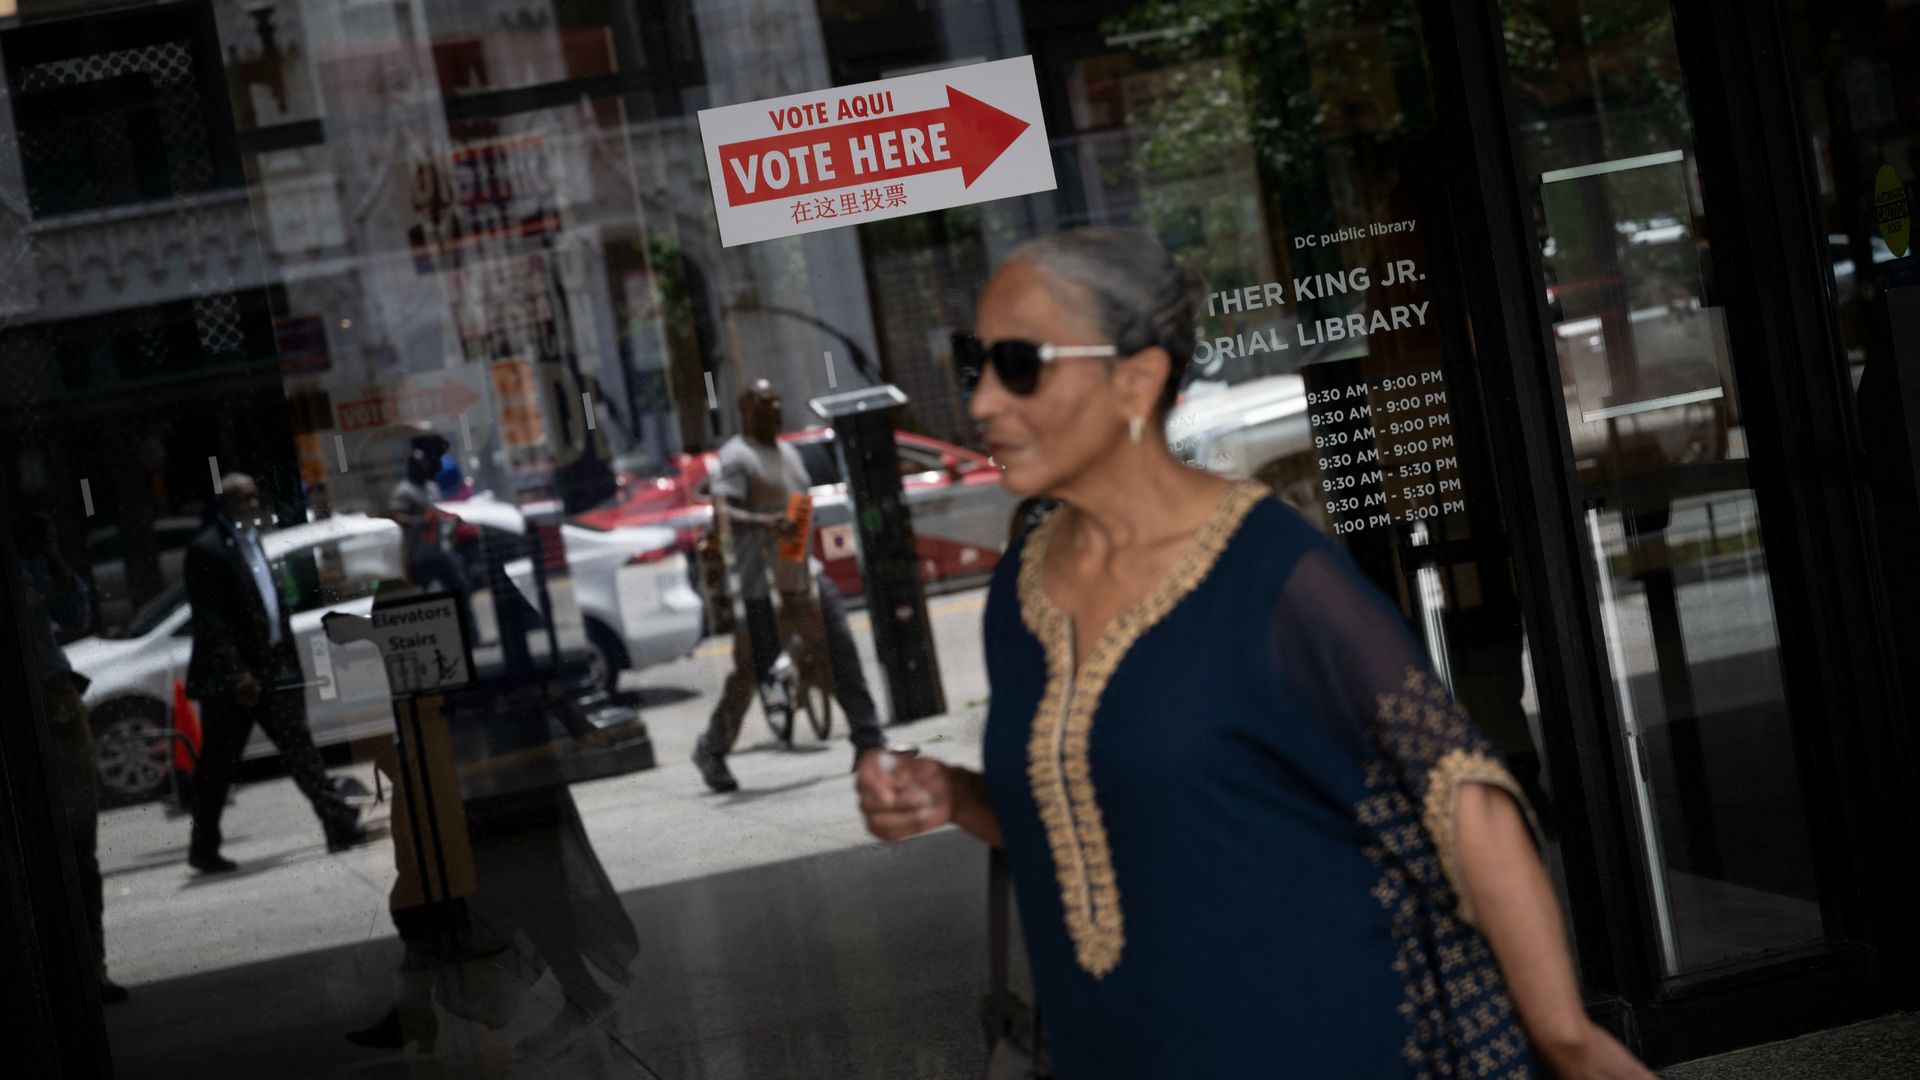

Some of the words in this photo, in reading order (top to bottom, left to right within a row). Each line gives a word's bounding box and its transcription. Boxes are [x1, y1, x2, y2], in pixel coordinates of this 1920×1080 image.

[768, 102, 829, 131] VOTE
[837, 91, 894, 120] AQUI
[729, 142, 836, 194] VOTE
[848, 122, 951, 175] HERE
[790, 182, 907, 225] 在这里投票
[1876, 200, 1909, 221] CAUTION
[1294, 234, 1317, 249] DC
[1320, 226, 1366, 247] public
[1369, 219, 1416, 237] library
[1207, 282, 1285, 317] THER
[1293, 267, 1371, 302] KING
[1380, 259, 1427, 287] JR.
[1192, 327, 1289, 364] ORIAL
[1296, 301, 1430, 347] LIBRARY
[1308, 388, 1340, 405] 9:30
[1346, 383, 1368, 398] AM
[1383, 375, 1416, 391] 9:00
[1421, 370, 1443, 384] PM
[1312, 410, 1344, 426] 9:30
[1350, 405, 1372, 420] AM
[1387, 397, 1420, 413] 9:00
[1425, 391, 1447, 406] PM
[1315, 432, 1348, 448] 9:30
[1354, 427, 1376, 442] AM
[1390, 418, 1424, 435] 9:00
[1429, 413, 1451, 428] PM
[1319, 454, 1352, 470] 9:30
[1357, 449, 1380, 464] AM
[1394, 440, 1428, 457] 9:00
[1432, 435, 1454, 450] PM
[1323, 475, 1355, 492] 9:30
[1361, 471, 1383, 485] AM
[1400, 461, 1431, 478] 5:30
[1436, 457, 1458, 471] PM
[1327, 497, 1359, 514] 9:30
[1365, 492, 1387, 507] AM
[1403, 483, 1435, 499] 5:30
[1440, 479, 1462, 493] PM
[1334, 519, 1364, 535] 1:00
[1369, 513, 1391, 527] PM
[1405, 505, 1439, 521] 5:00
[1443, 500, 1465, 515] PM
[372, 606, 452, 629] Elevators
[388, 632, 437, 651] Stairs
